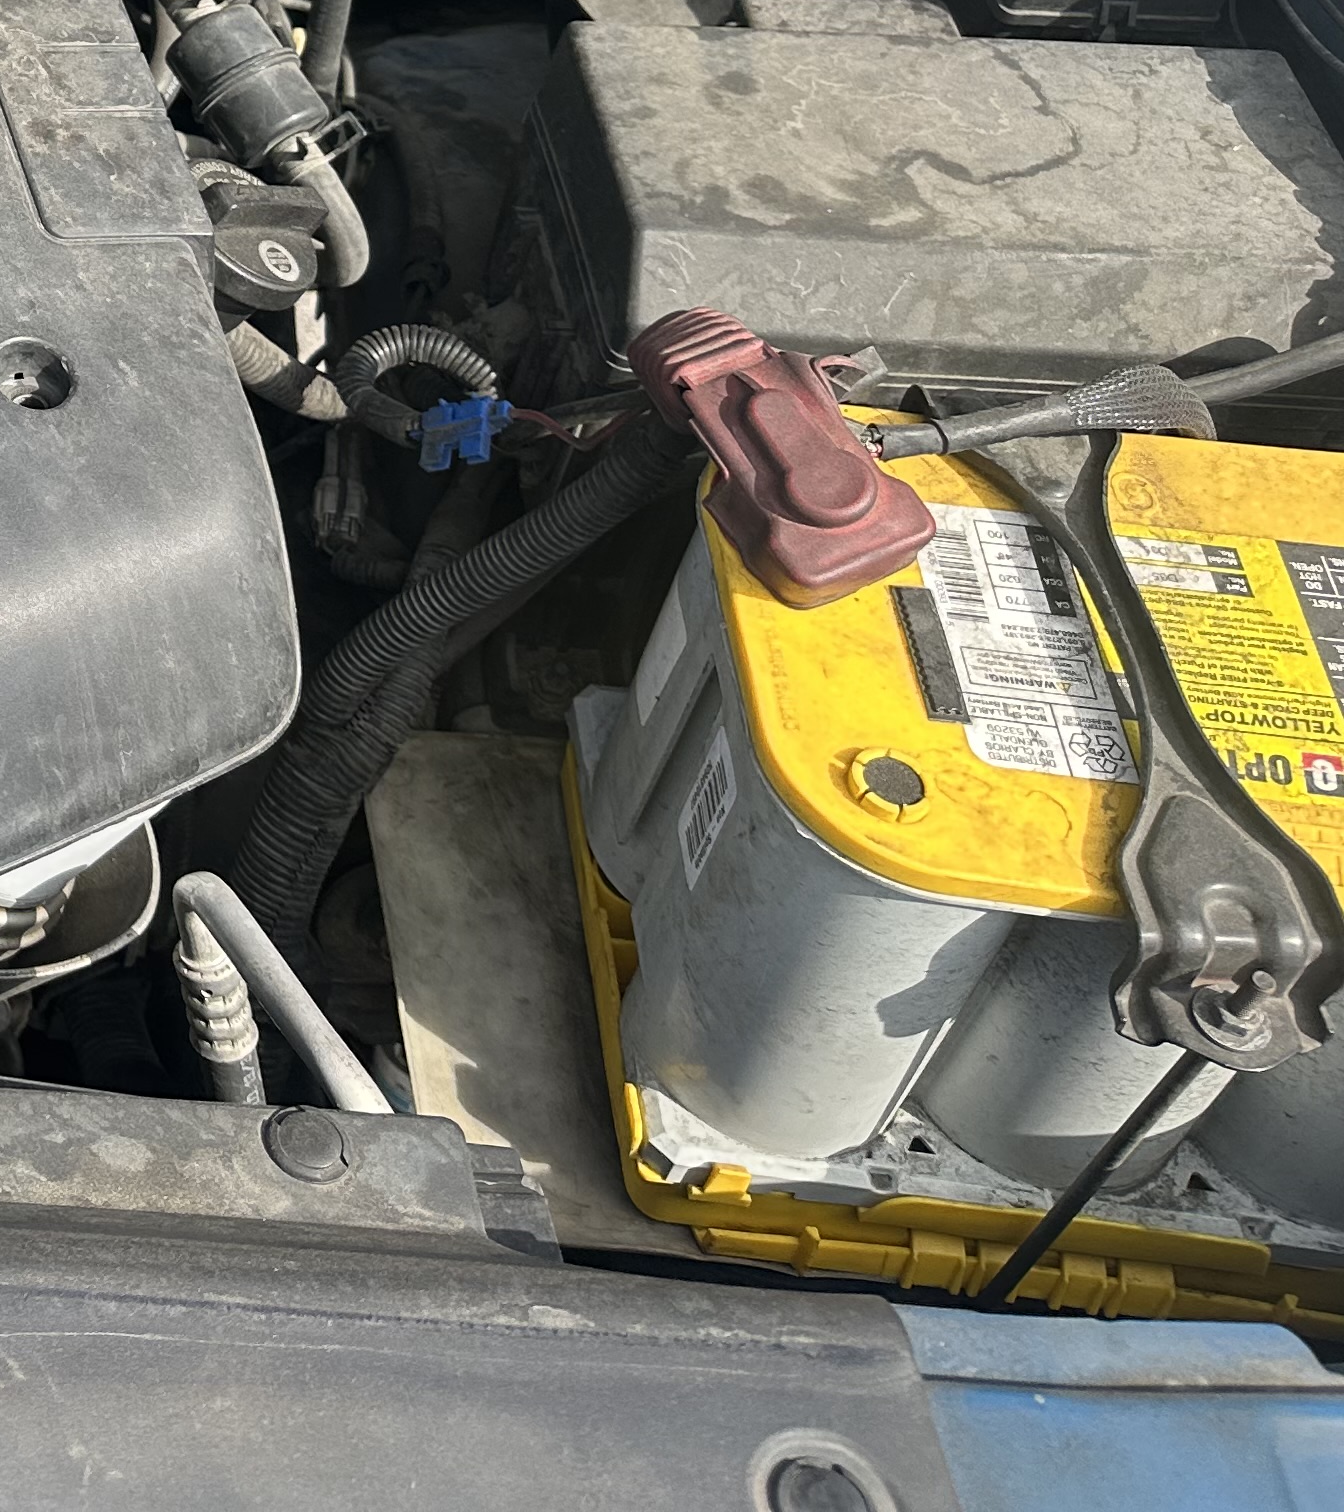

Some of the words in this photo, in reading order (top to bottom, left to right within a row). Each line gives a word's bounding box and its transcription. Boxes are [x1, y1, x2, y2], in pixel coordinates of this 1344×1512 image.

[1299, 571, 1321, 580] NOT
[1042, 577, 1063, 587] CCA
[1305, 581, 1322, 590] DO
[1005, 596, 1029, 606] 770
[1055, 600, 1070, 609] CA
[1220, 674, 1247, 684] FREE
[1188, 695, 1248, 708] STARTING
[1262, 703, 1300, 715] CYCLE
[1302, 708, 1334, 718] DEEP
[1039, 749, 1054, 758] BY
[988, 751, 1056, 768] DISTRIBUTED
[1221, 749, 1292, 785] OPT
